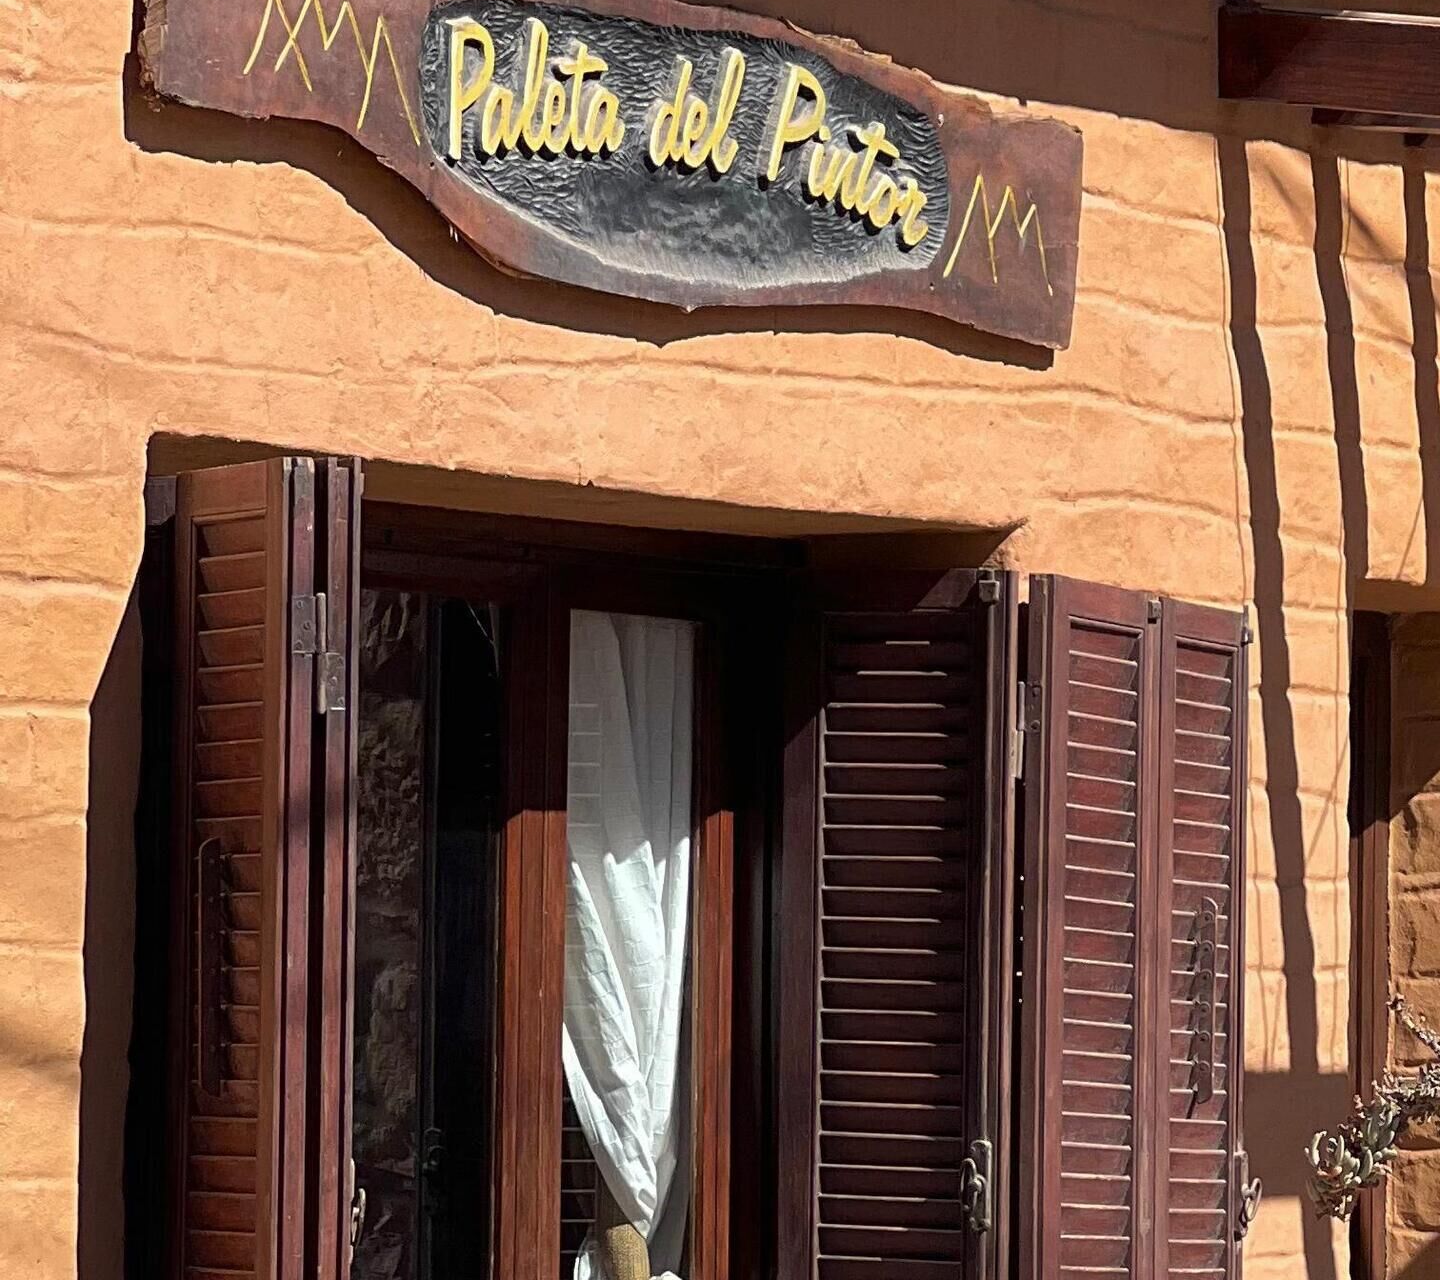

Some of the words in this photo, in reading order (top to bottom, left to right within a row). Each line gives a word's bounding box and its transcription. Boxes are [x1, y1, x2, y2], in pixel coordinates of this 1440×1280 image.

[444, 16, 625, 161] Paleta
[650, 45, 747, 175] del
[765, 61, 930, 247] Pintor
